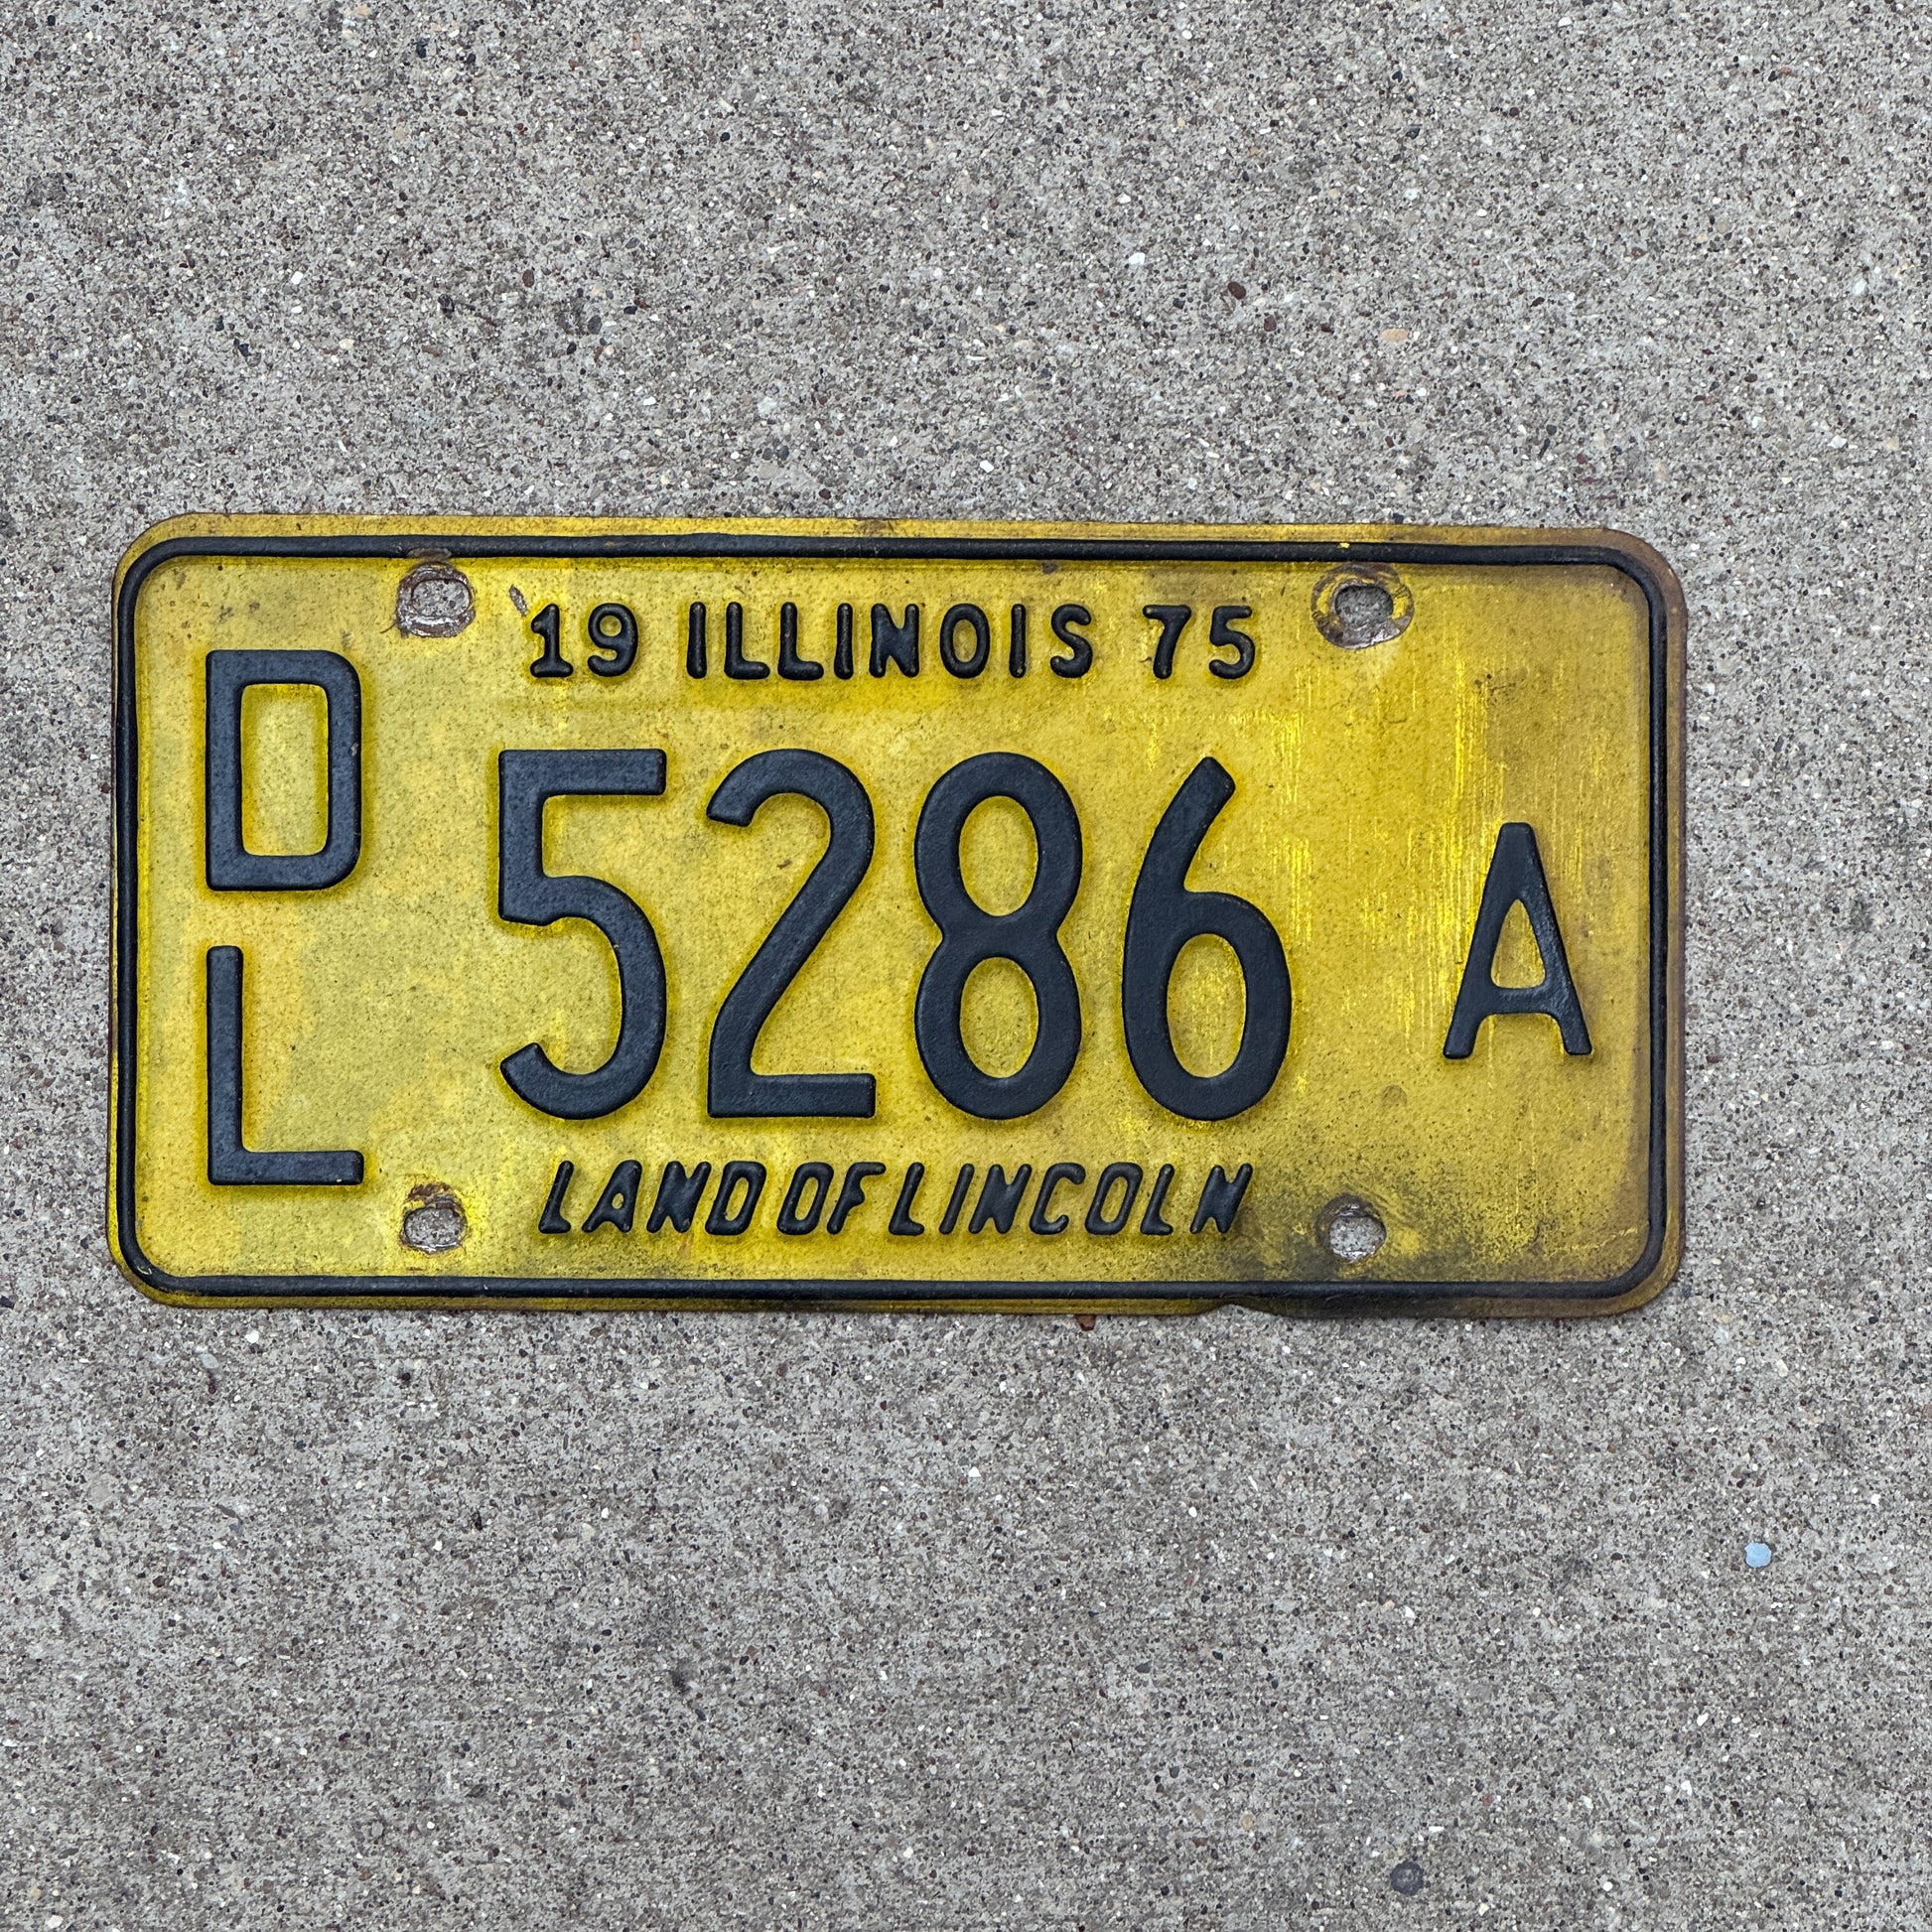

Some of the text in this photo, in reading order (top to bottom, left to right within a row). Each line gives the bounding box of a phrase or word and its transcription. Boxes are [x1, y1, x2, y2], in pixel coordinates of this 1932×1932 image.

[529, 602, 1256, 682] 19 ILLINOIS 75
[498, 749, 1592, 1122] 5286 A
[537, 1160, 1255, 1238] LAND OF LINCOLN
